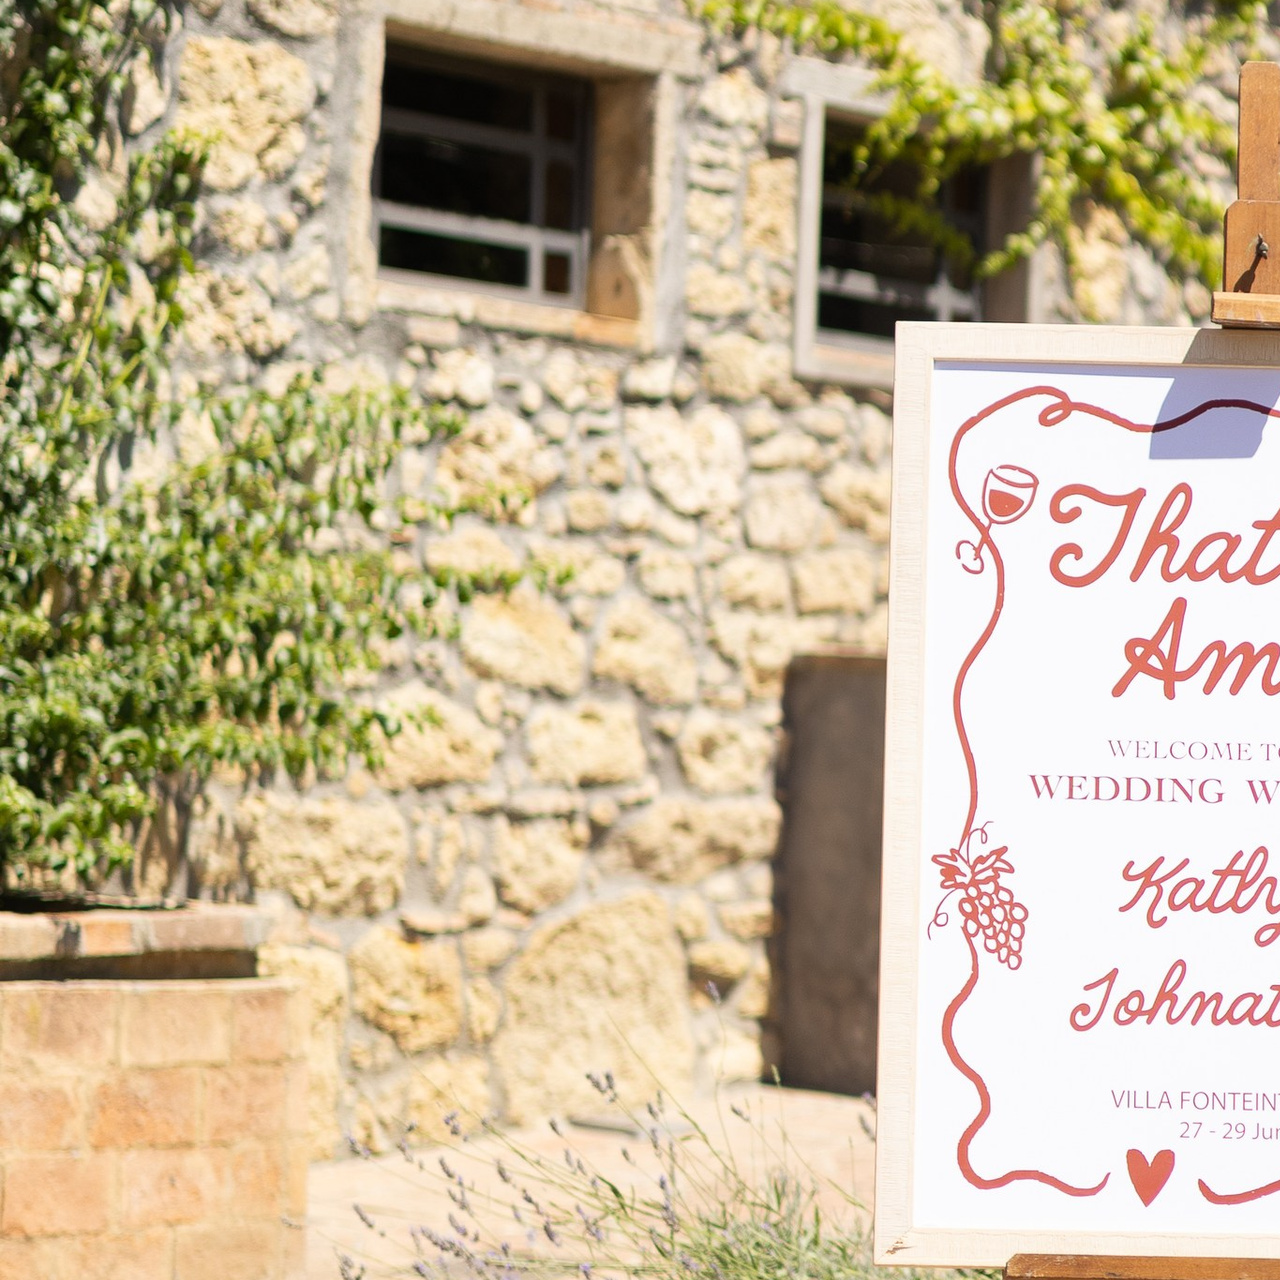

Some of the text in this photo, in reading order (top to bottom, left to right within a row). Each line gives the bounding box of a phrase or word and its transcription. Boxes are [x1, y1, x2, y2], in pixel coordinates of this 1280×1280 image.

[1108, 740, 1252, 760] WELCOME
[1028, 775, 1225, 804] WEDDING
[1111, 1090, 1172, 1109] VILLA
[1180, 1122, 1202, 1138] 27
[1222, 1122, 1246, 1139] 29
